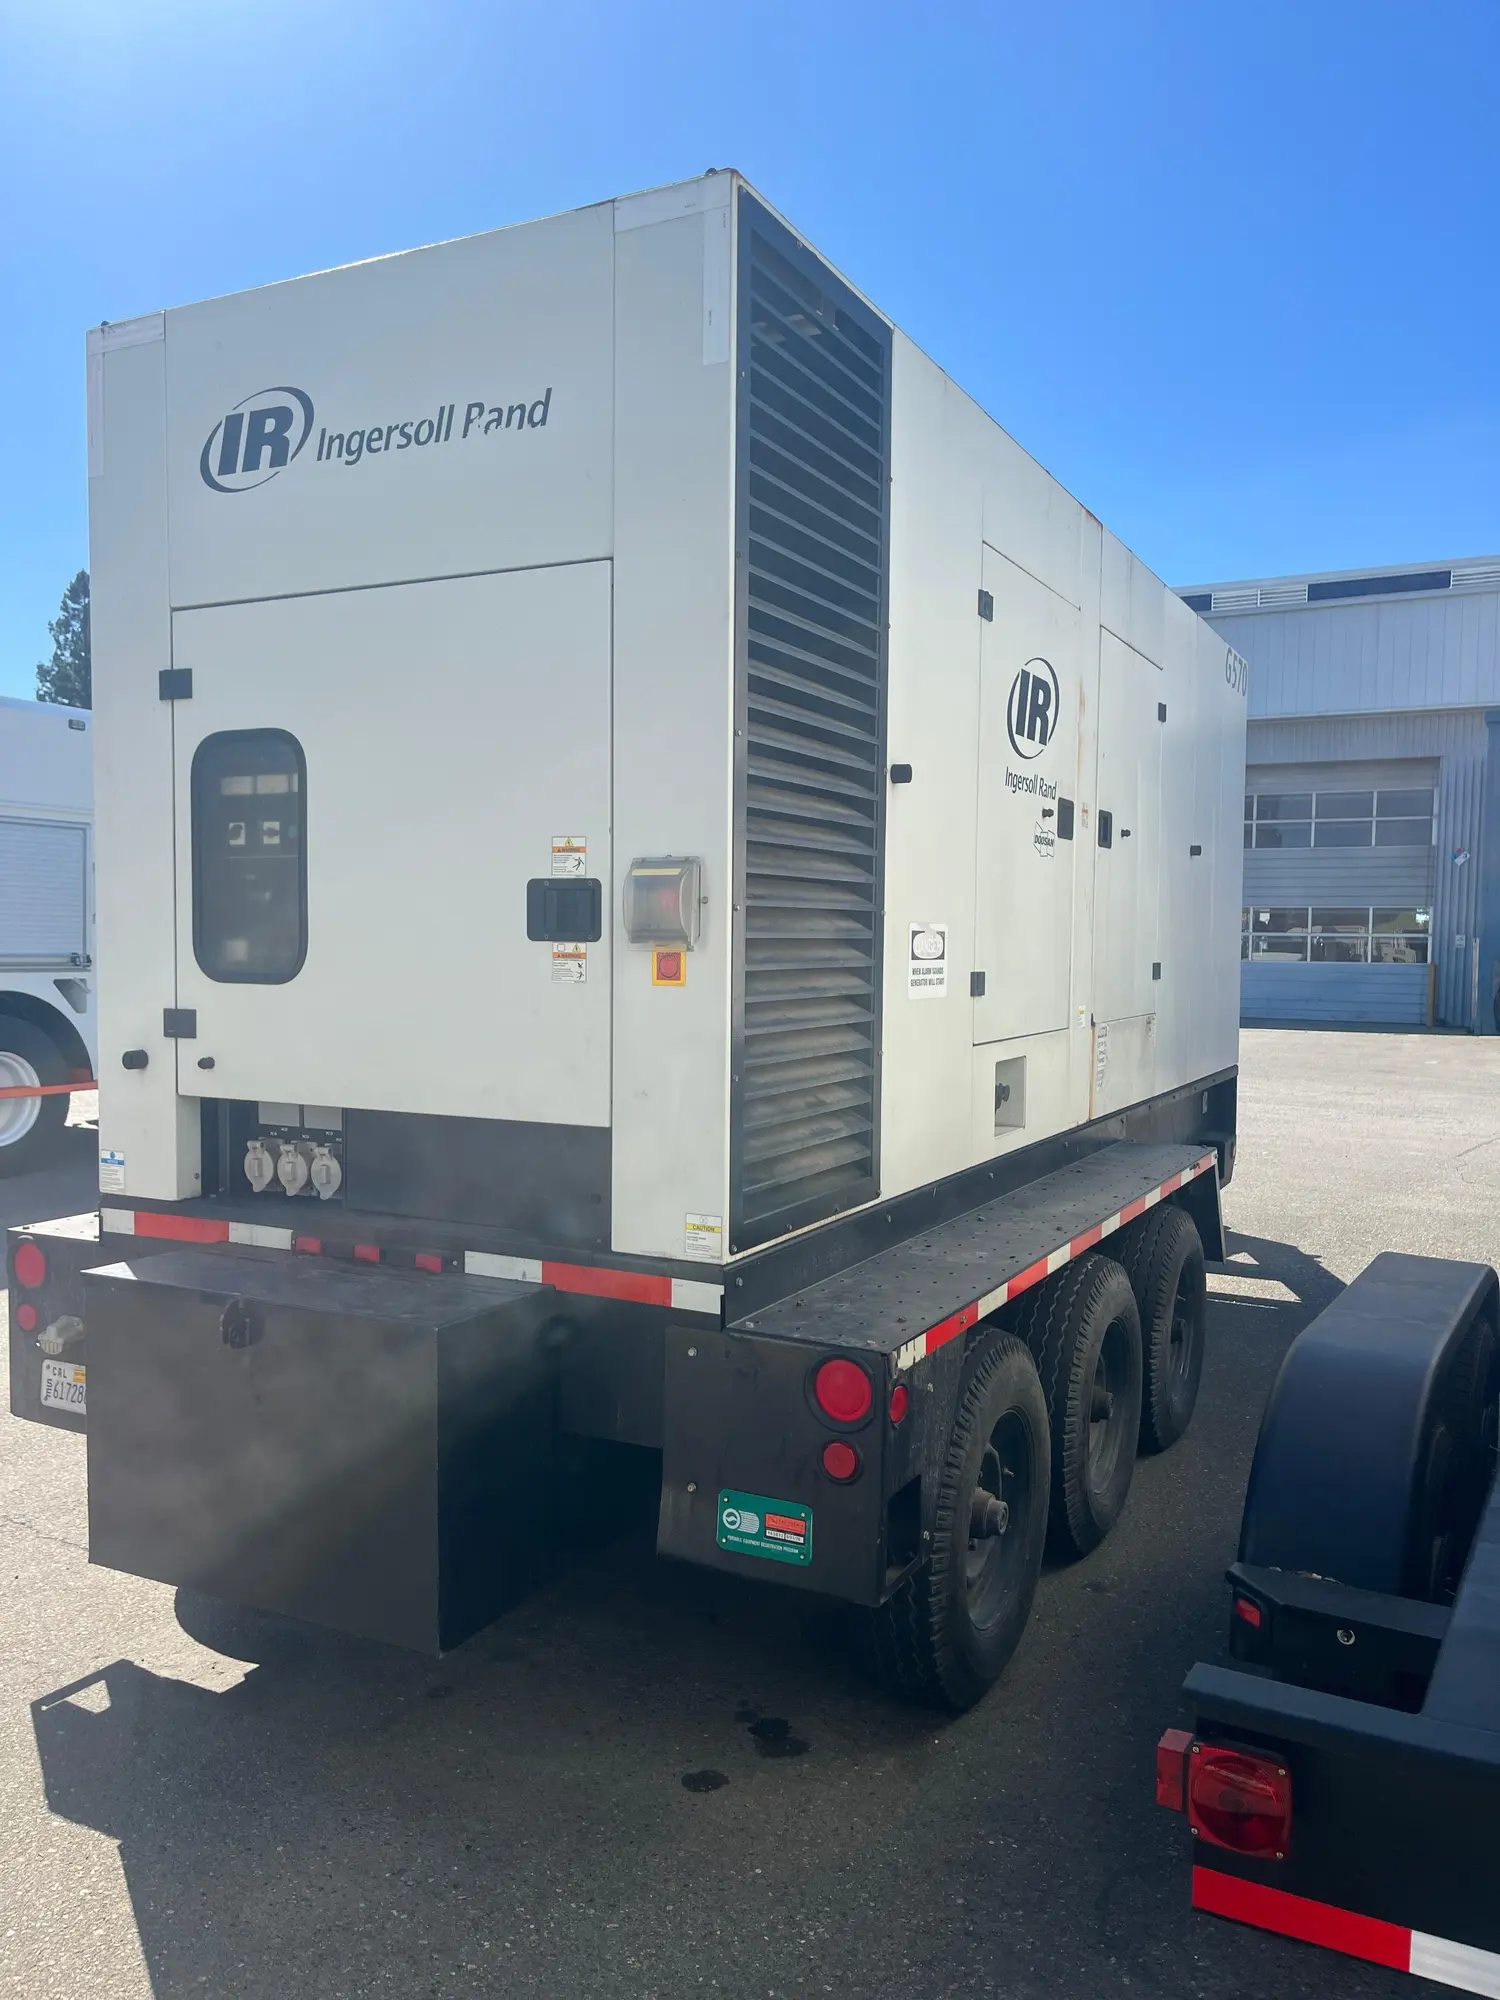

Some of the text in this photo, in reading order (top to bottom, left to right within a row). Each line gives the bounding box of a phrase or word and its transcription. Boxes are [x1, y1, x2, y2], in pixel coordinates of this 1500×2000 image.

[217, 405, 294, 477] IR
[316, 404, 455, 466] Ingersoll
[1225, 646, 1248, 697] G570
[1015, 668, 1051, 746] IR
[1005, 766, 1057, 801] Ingersoll Rand
[1034, 833, 1055, 848] DOOSAN
[912, 967, 921, 975] WHEN
[922, 967, 931, 975] ALARM
[911, 978, 945, 987] GENERATOR WILL START
[693, 1224, 715, 1232] CAUTION
[52, 1366, 67, 1379] CAL
[743, 1538, 760, 1546] EQUIPMENT
[761, 1542, 782, 1551] REGISTRATION
[783, 1546, 799, 1554] PROGRAM
